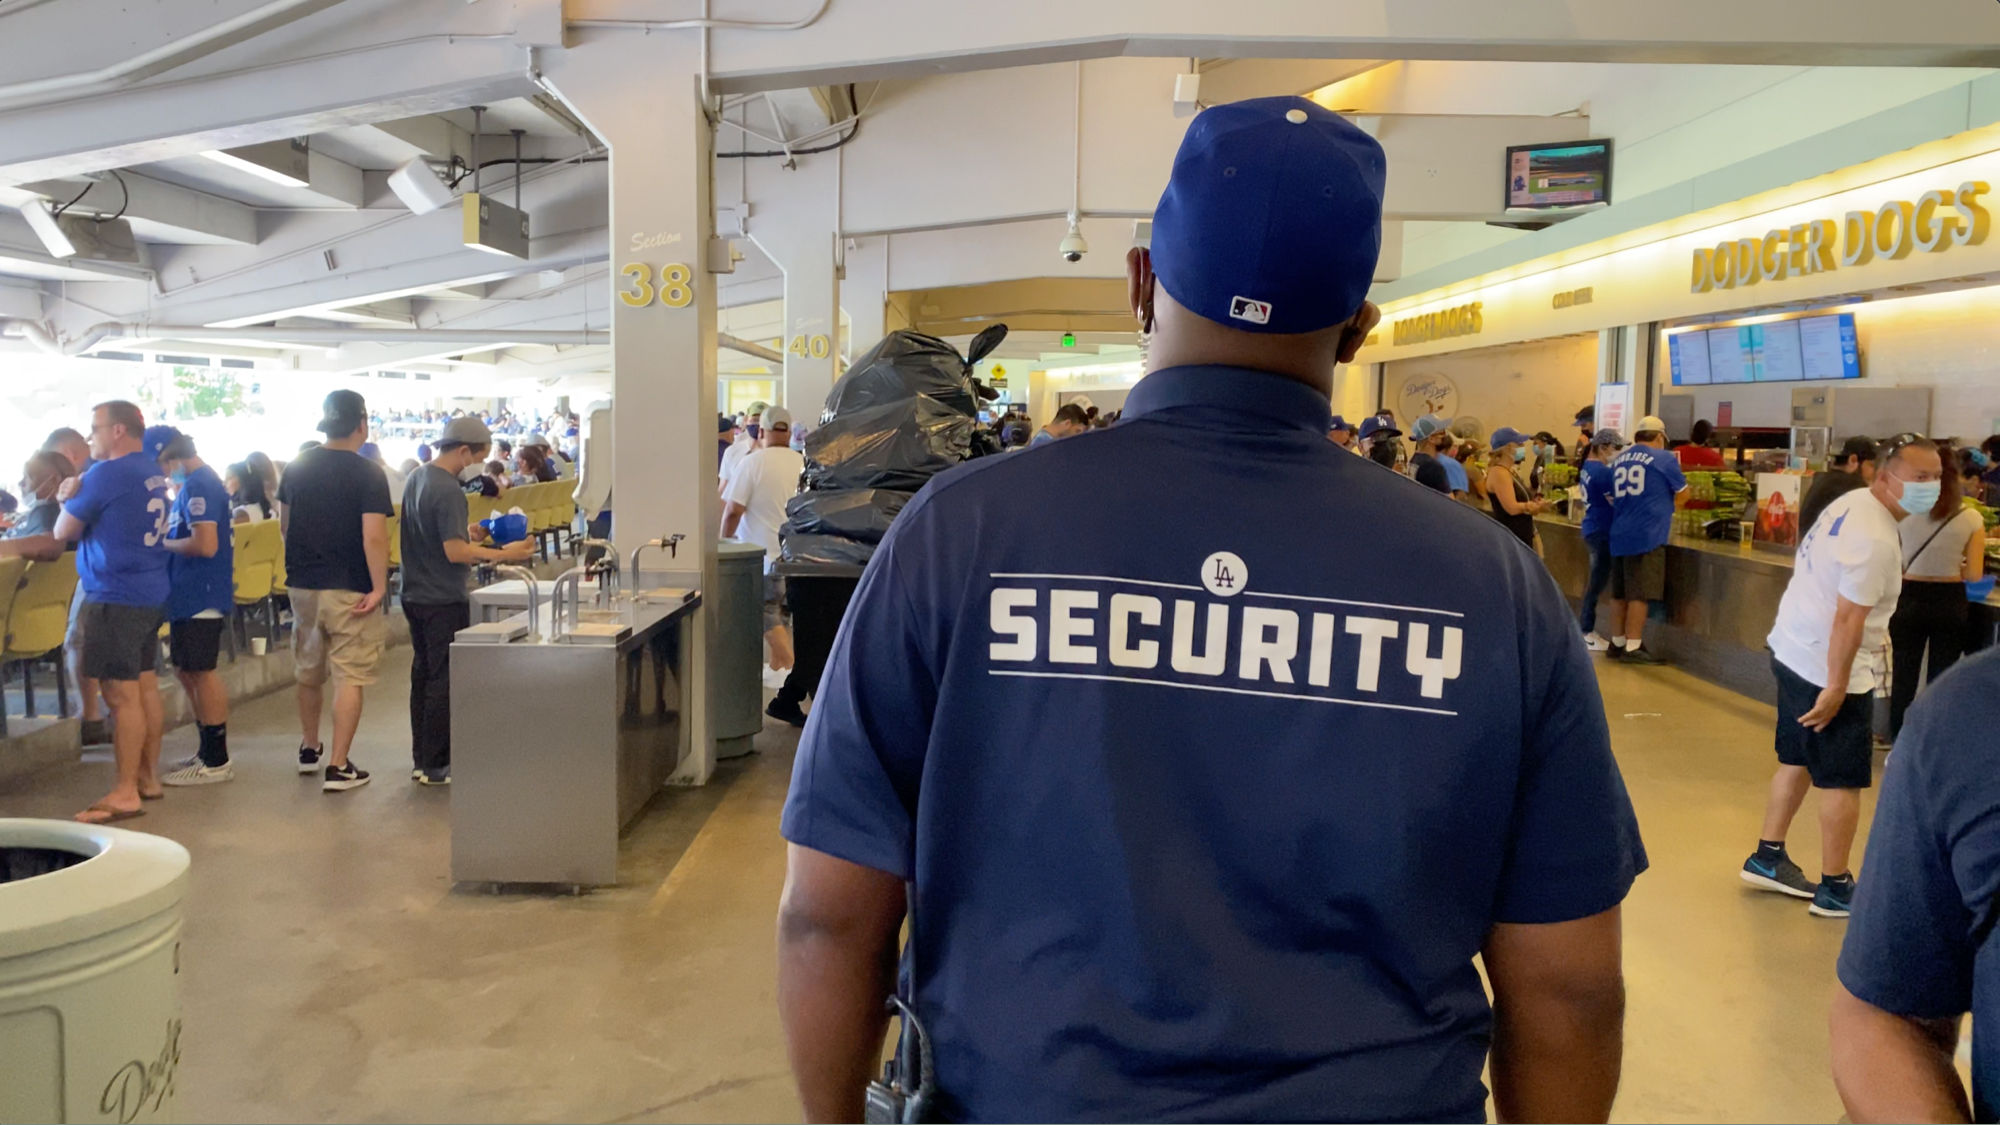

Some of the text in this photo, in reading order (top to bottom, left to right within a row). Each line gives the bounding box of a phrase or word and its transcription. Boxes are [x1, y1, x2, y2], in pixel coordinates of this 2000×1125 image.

[630, 231, 681, 252] Section
[1691, 181, 1990, 293] DODGER DOGS
[619, 262, 693, 308] 38
[788, 334, 830, 359] 40
[1614, 464, 1646, 498] 29
[1214, 558, 1235, 589] LA
[989, 587, 1464, 699] SECURITY
